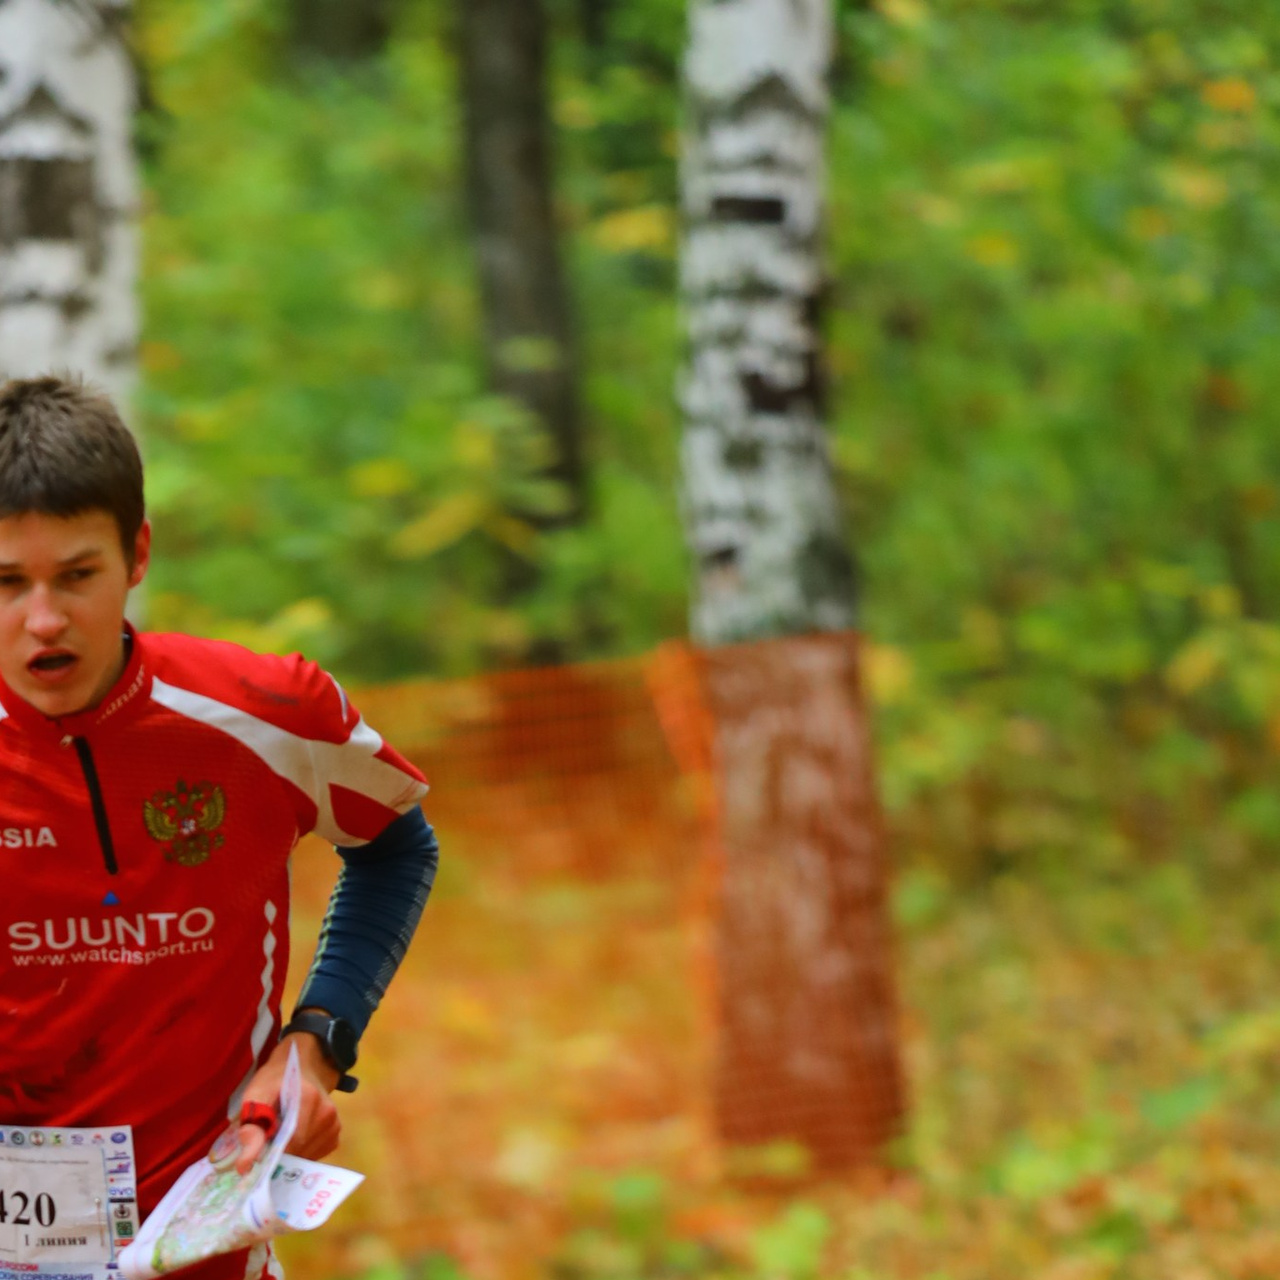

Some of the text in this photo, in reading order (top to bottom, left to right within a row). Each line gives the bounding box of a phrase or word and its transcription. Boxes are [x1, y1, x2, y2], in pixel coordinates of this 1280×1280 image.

[8, 907, 215, 951] SUUNTO
[12, 938, 215, 967] www.watchsport.ru
[36, 1236, 88, 1247] линия
[6, 1259, 39, 1272] РОССИИ
